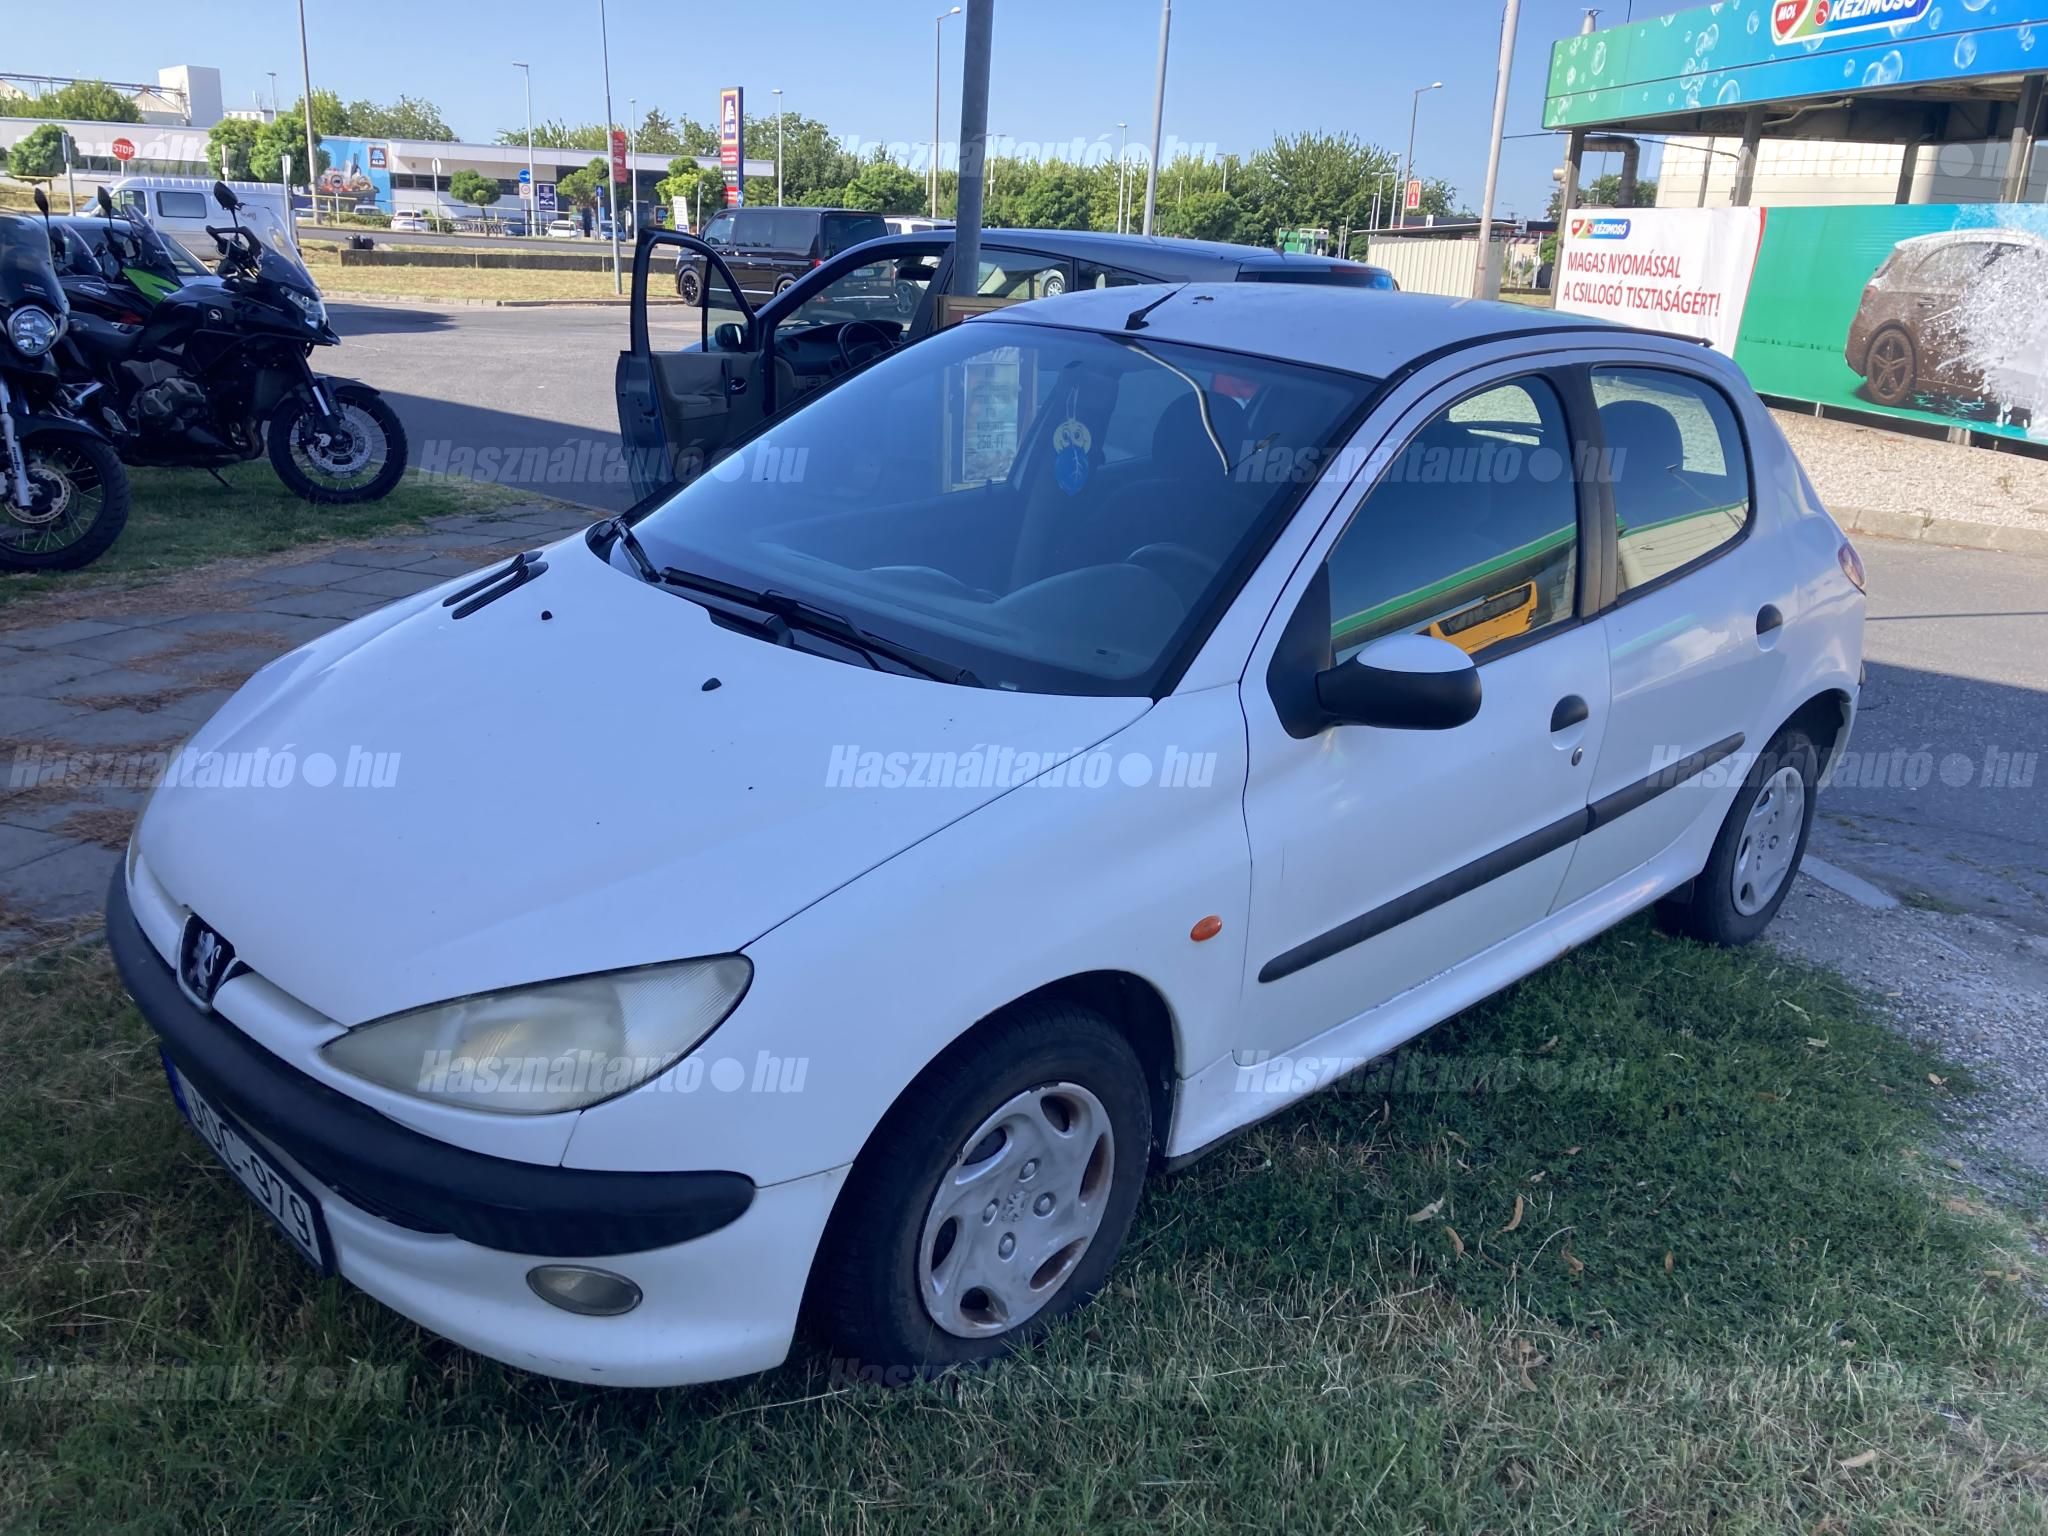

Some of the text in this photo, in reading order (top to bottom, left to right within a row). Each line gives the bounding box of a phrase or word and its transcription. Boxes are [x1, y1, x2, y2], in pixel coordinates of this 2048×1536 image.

[113, 144, 134, 155] STOP
[1568, 250, 1681, 279] MAGAS NYOMÁSSAL
[1563, 280, 1721, 317] A CSILLOGÓ TISZTASÁGÉRT!
